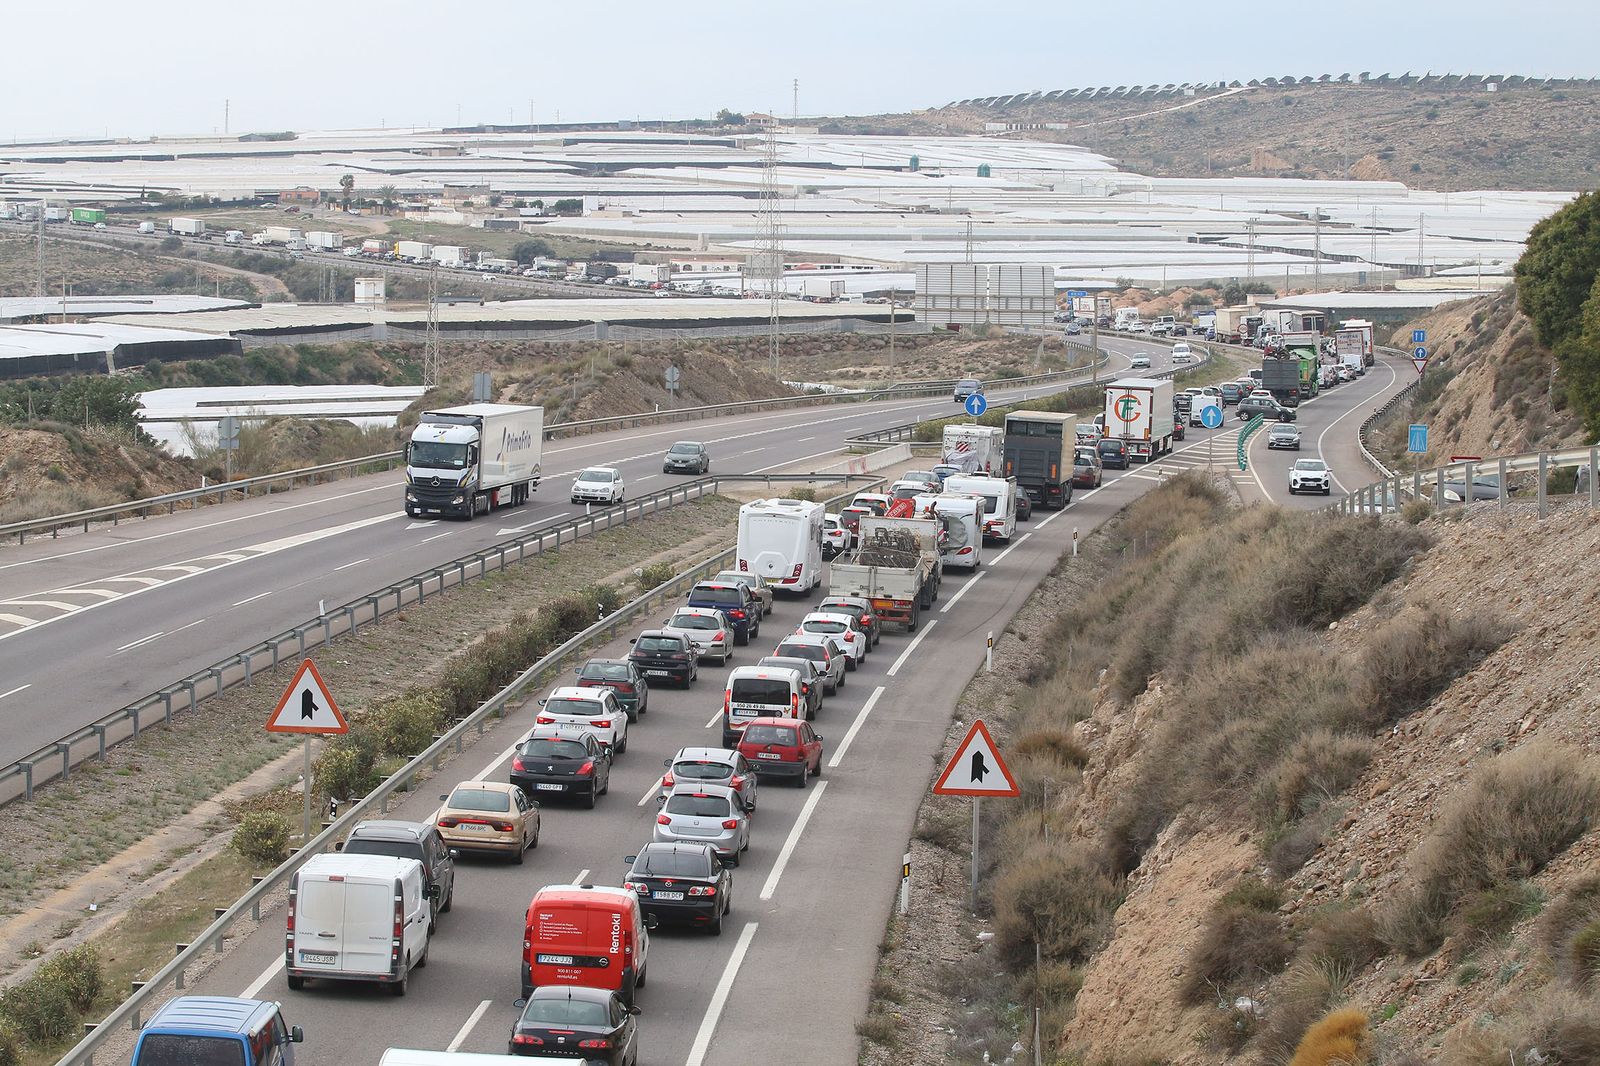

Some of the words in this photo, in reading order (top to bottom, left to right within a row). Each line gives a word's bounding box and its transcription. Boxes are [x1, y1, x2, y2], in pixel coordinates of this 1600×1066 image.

[610, 913, 621, 954] Rentokil
[304, 954, 321, 962] 9445
[322, 955, 334, 963] JSR
